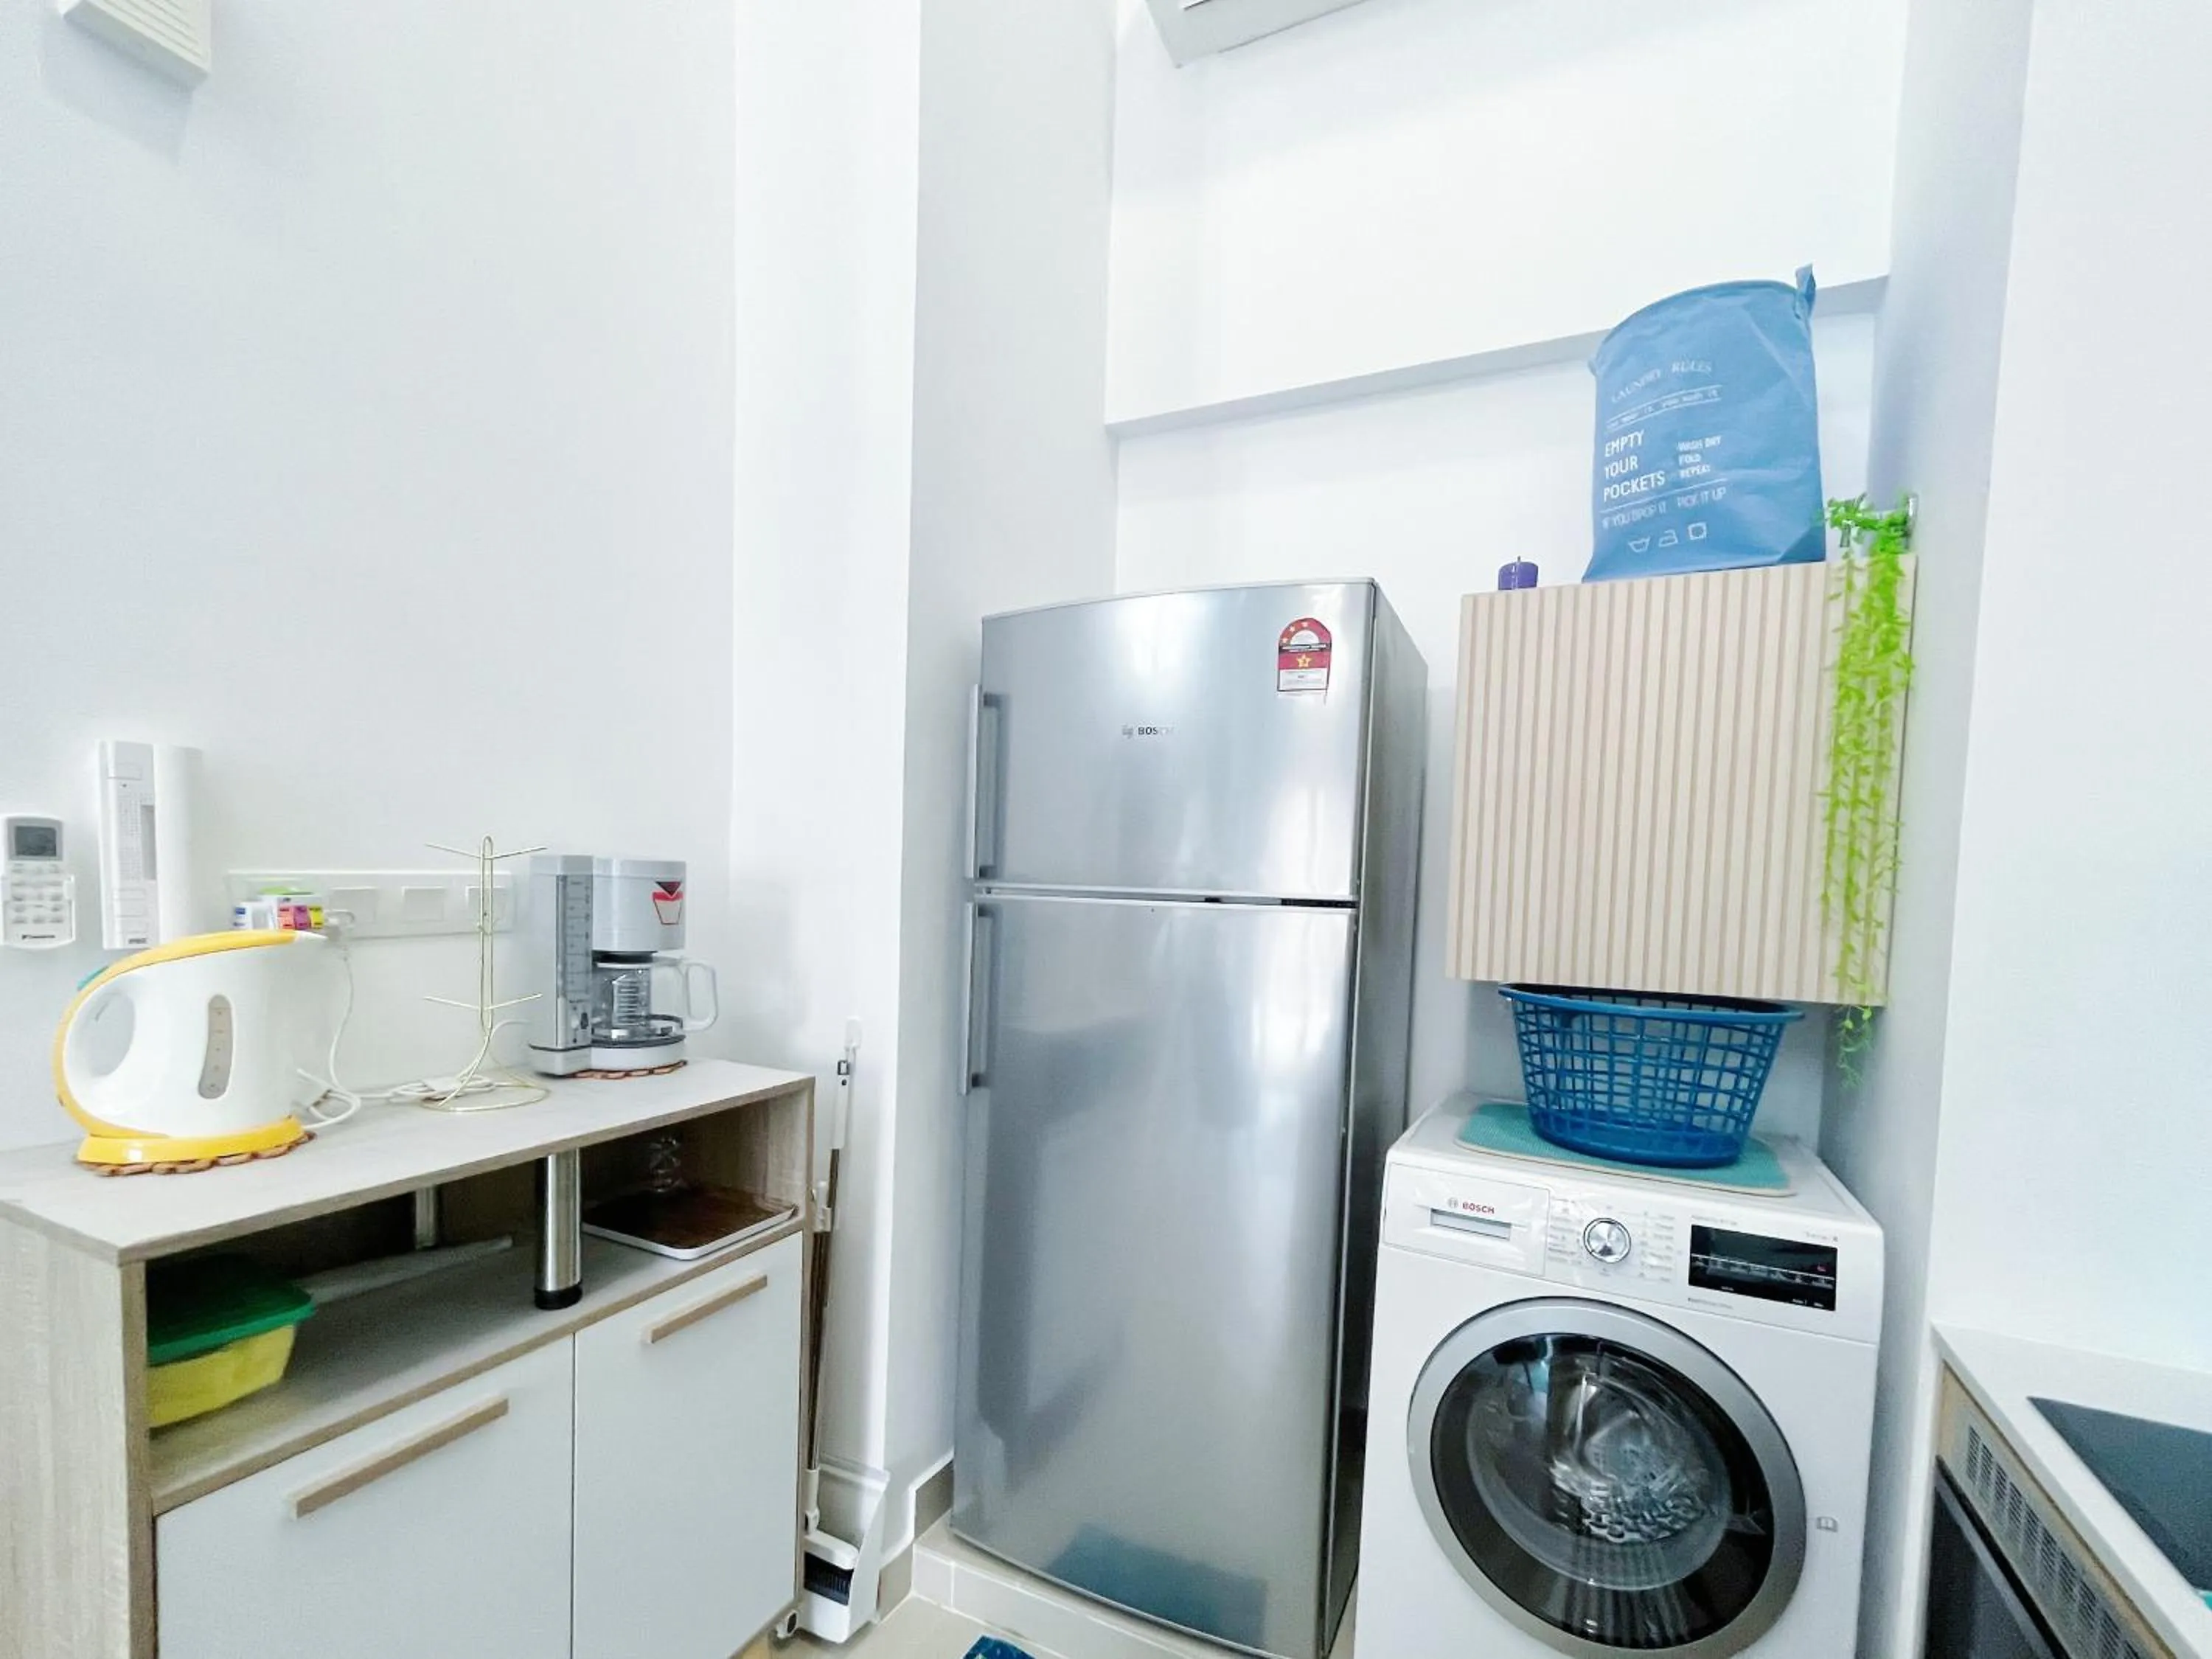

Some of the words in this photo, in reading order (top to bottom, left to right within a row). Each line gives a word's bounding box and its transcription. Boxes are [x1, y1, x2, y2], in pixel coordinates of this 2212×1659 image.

[1604, 428, 1645, 457] EMPTY
[1604, 455, 1638, 479] YOUR
[1604, 470, 1666, 502] POCKETS
[1700, 490, 1709, 502] IT
[1711, 487, 1727, 501] UP
[1462, 1201, 1495, 1214] BOSCH
